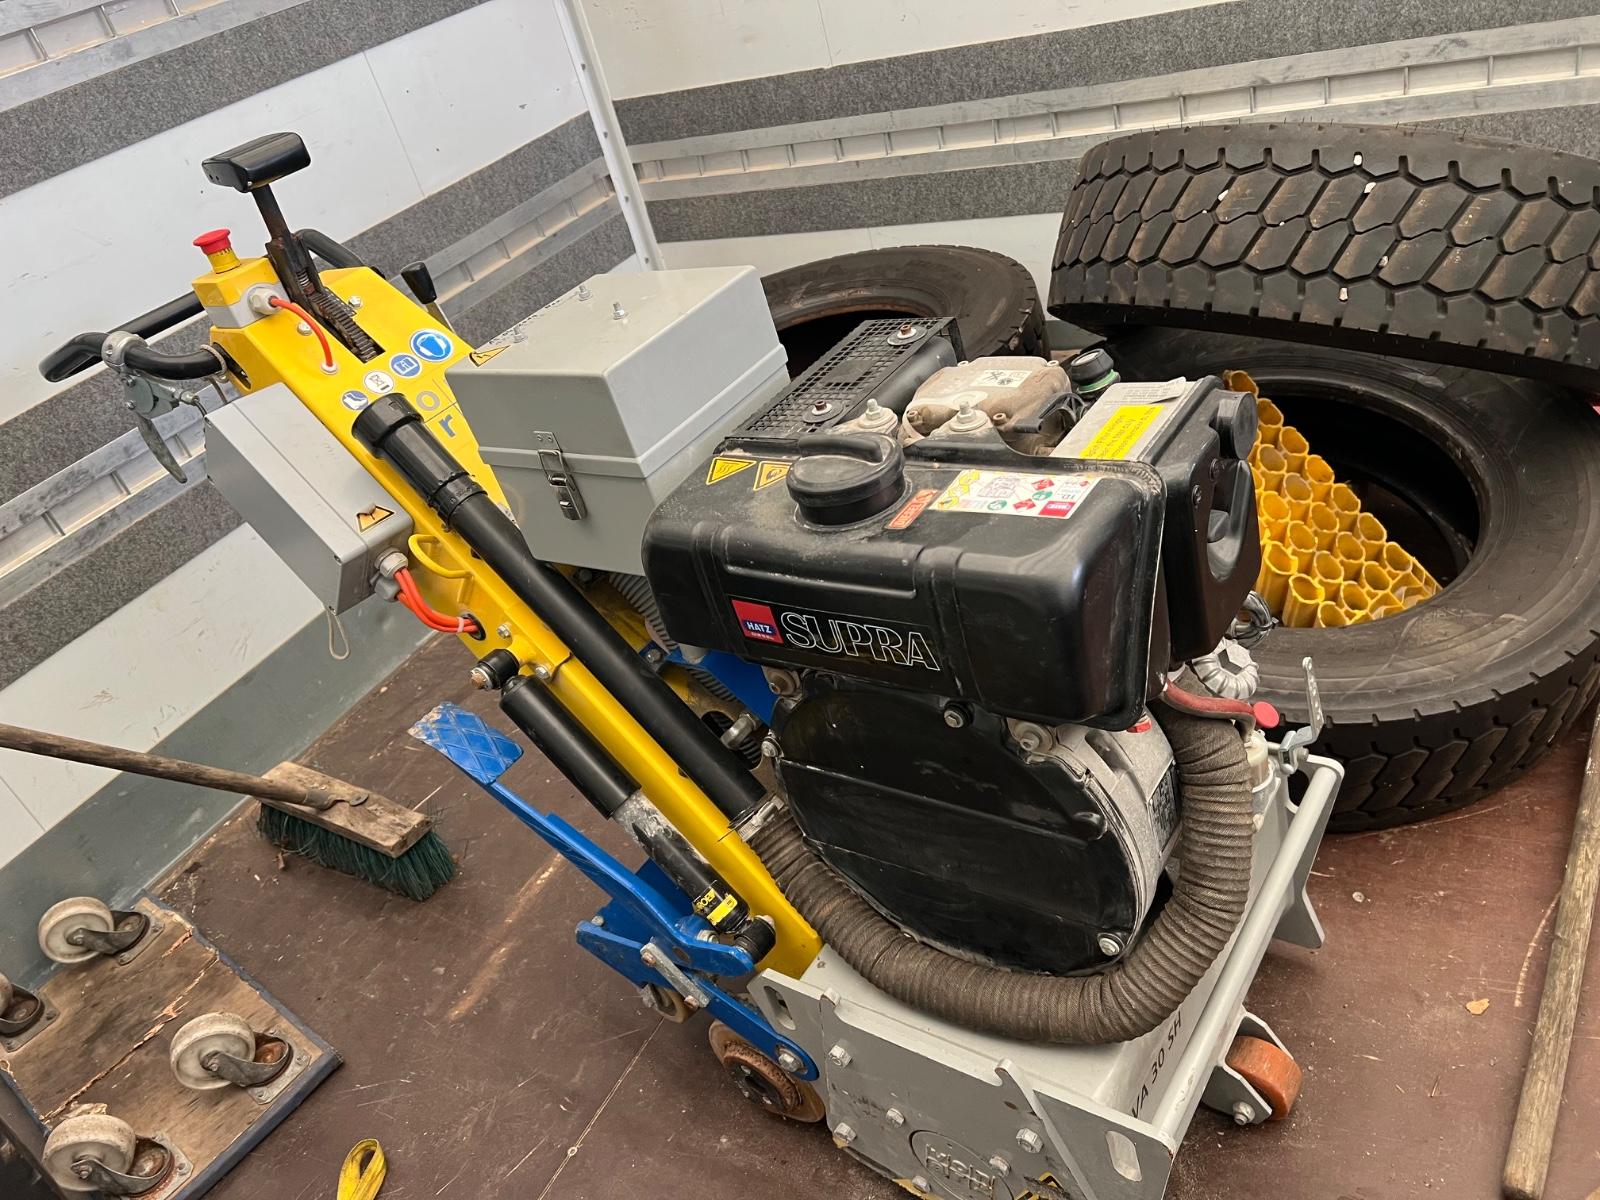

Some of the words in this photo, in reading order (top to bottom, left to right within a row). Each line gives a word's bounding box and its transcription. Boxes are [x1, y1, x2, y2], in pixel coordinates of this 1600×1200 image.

[746, 621, 772, 634] HATZ
[780, 611, 941, 672] SUPRA
[1151, 1047, 1165, 1083] 30
[1167, 1009, 1182, 1050] SH
